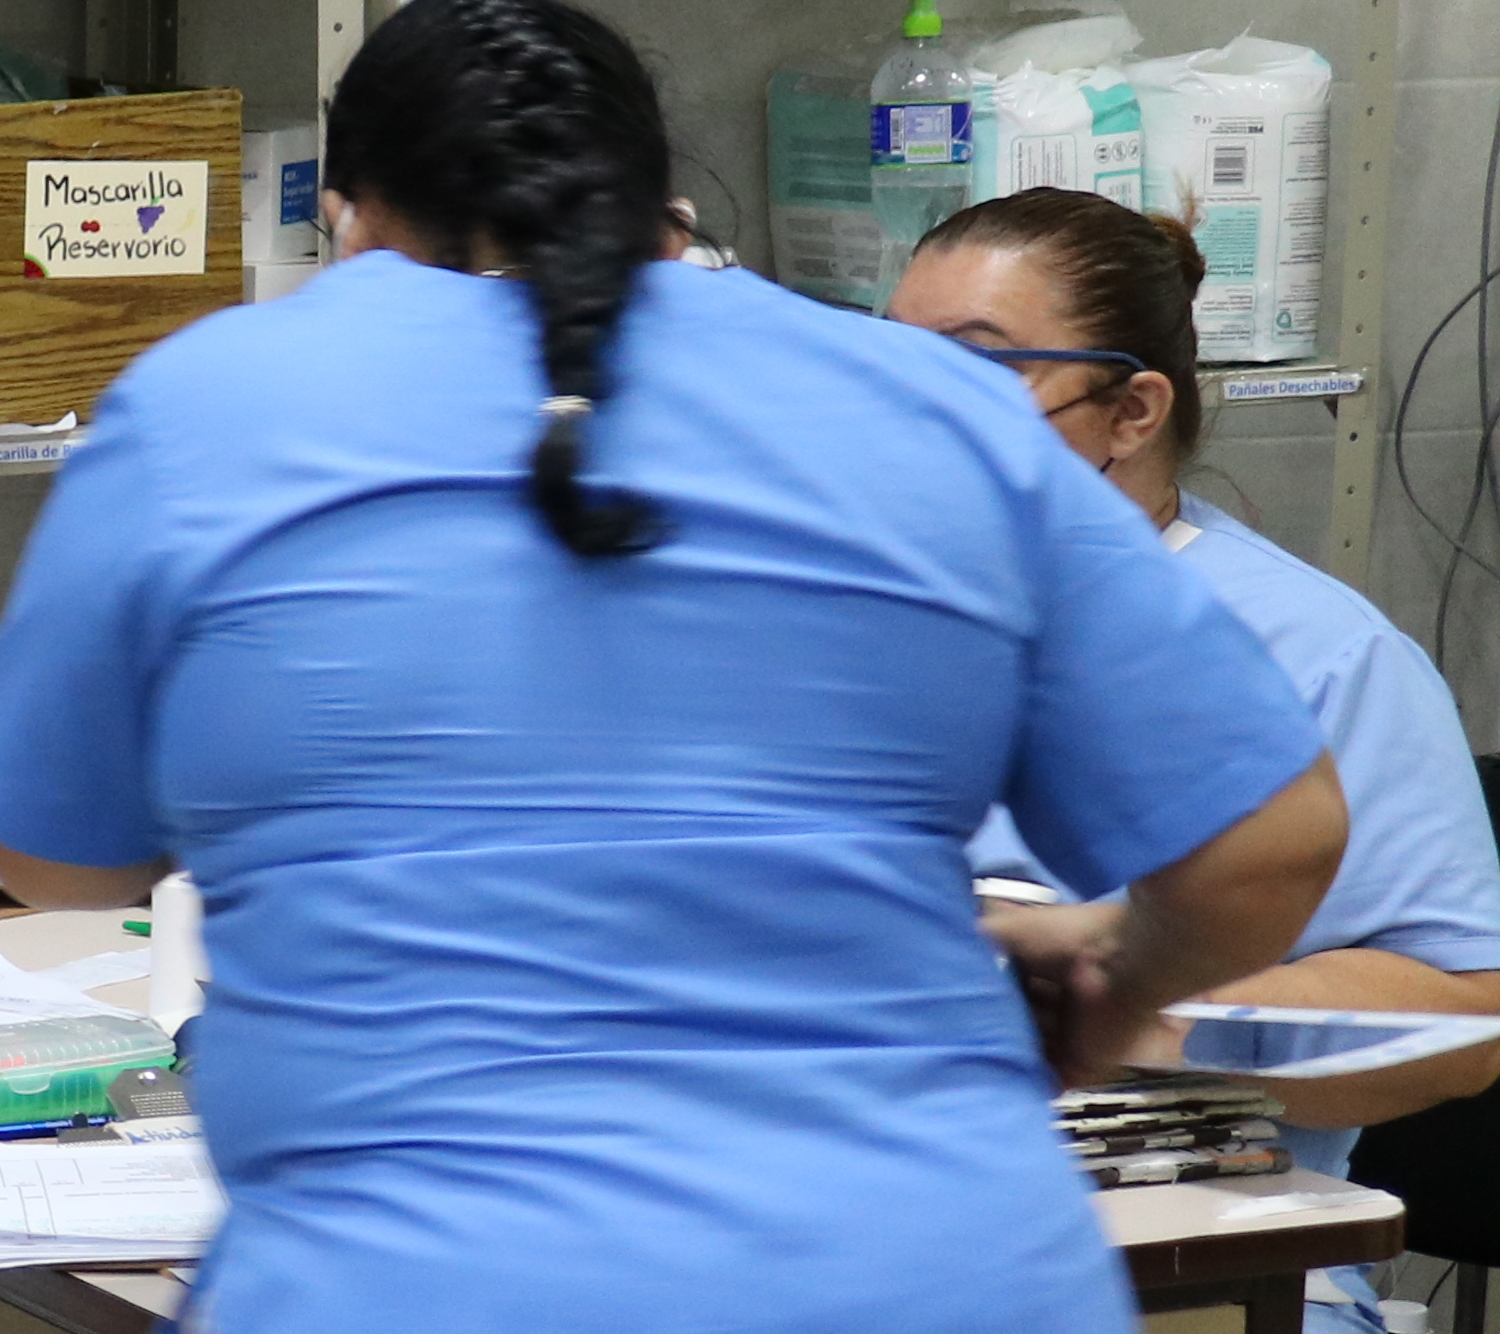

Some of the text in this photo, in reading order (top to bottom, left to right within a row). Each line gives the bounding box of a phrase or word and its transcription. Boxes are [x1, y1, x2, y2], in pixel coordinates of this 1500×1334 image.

[44, 171, 183, 207] Mascarilla
[38, 223, 187, 262] Reservorio
[1229, 378, 1355, 396] Pañales Desechables
[41, 444, 58, 457] de
